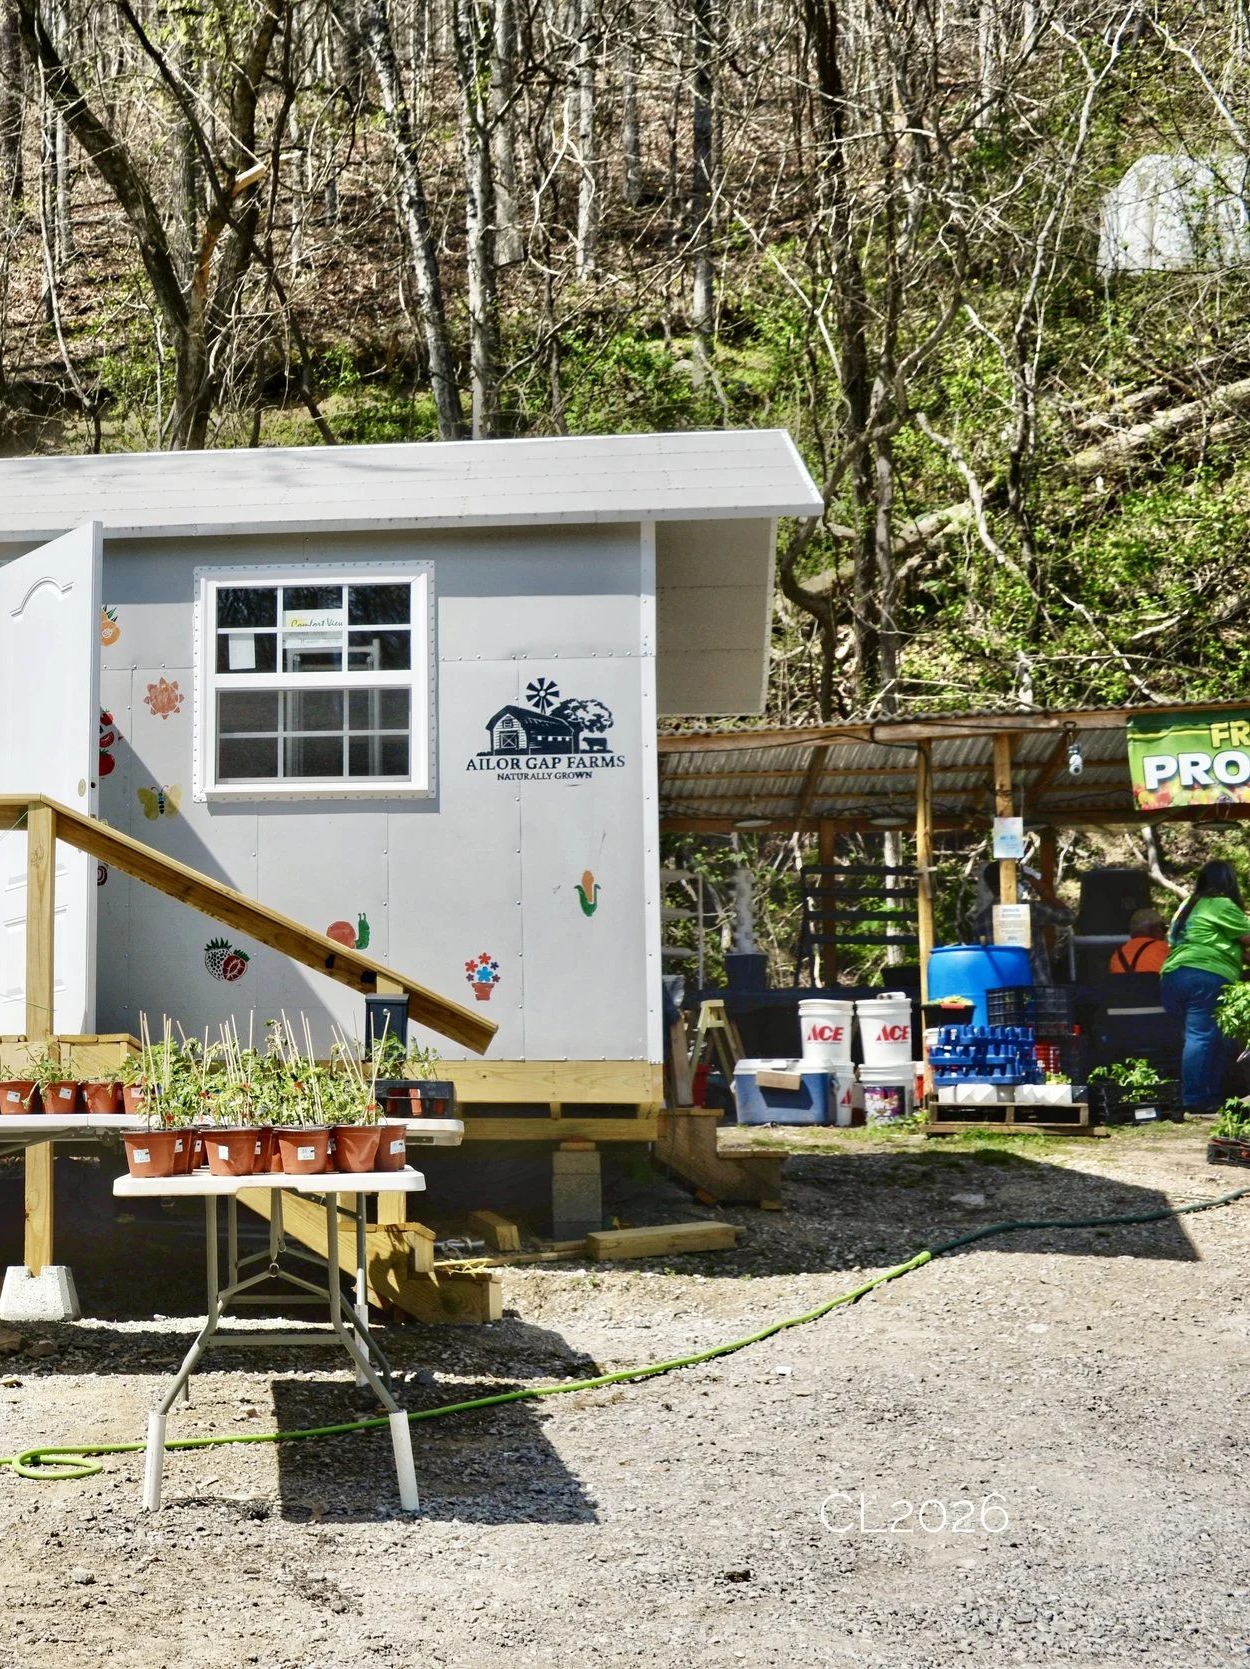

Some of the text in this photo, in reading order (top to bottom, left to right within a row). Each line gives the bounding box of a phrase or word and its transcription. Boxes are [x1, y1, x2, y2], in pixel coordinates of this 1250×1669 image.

[1210, 720, 1250, 748] FR
[466, 755, 625, 770] AILOR GAP FARMS
[1143, 750, 1250, 790] PRO
[554, 771, 592, 779] GROWN
[807, 1024, 844, 1041] ACE
[876, 1024, 910, 1041] ACE
